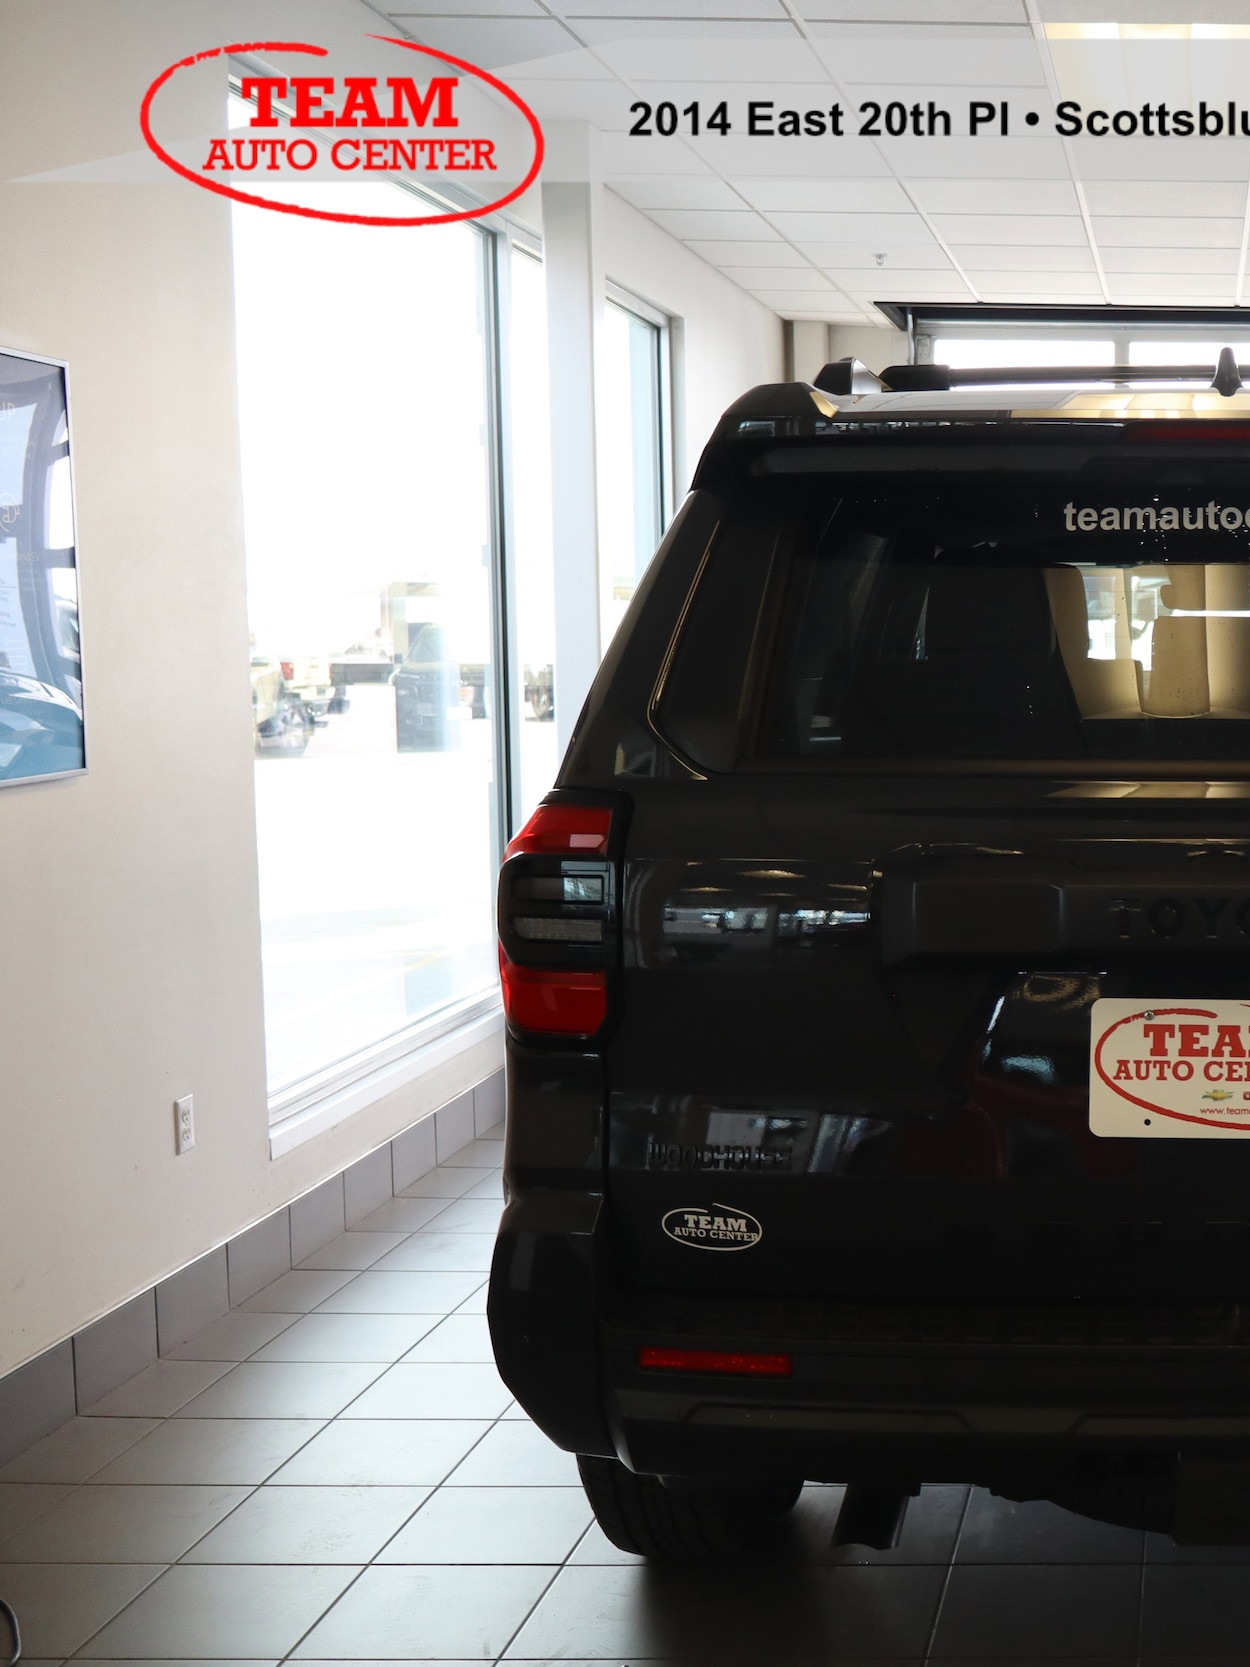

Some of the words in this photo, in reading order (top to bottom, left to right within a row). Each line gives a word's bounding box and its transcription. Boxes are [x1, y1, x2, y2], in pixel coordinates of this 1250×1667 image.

[1112, 1059, 1194, 1082] AUTO
[684, 1213, 748, 1233] TEAM
[674, 1226, 707, 1238] AUTO
[709, 1230, 759, 1241] CENTER
